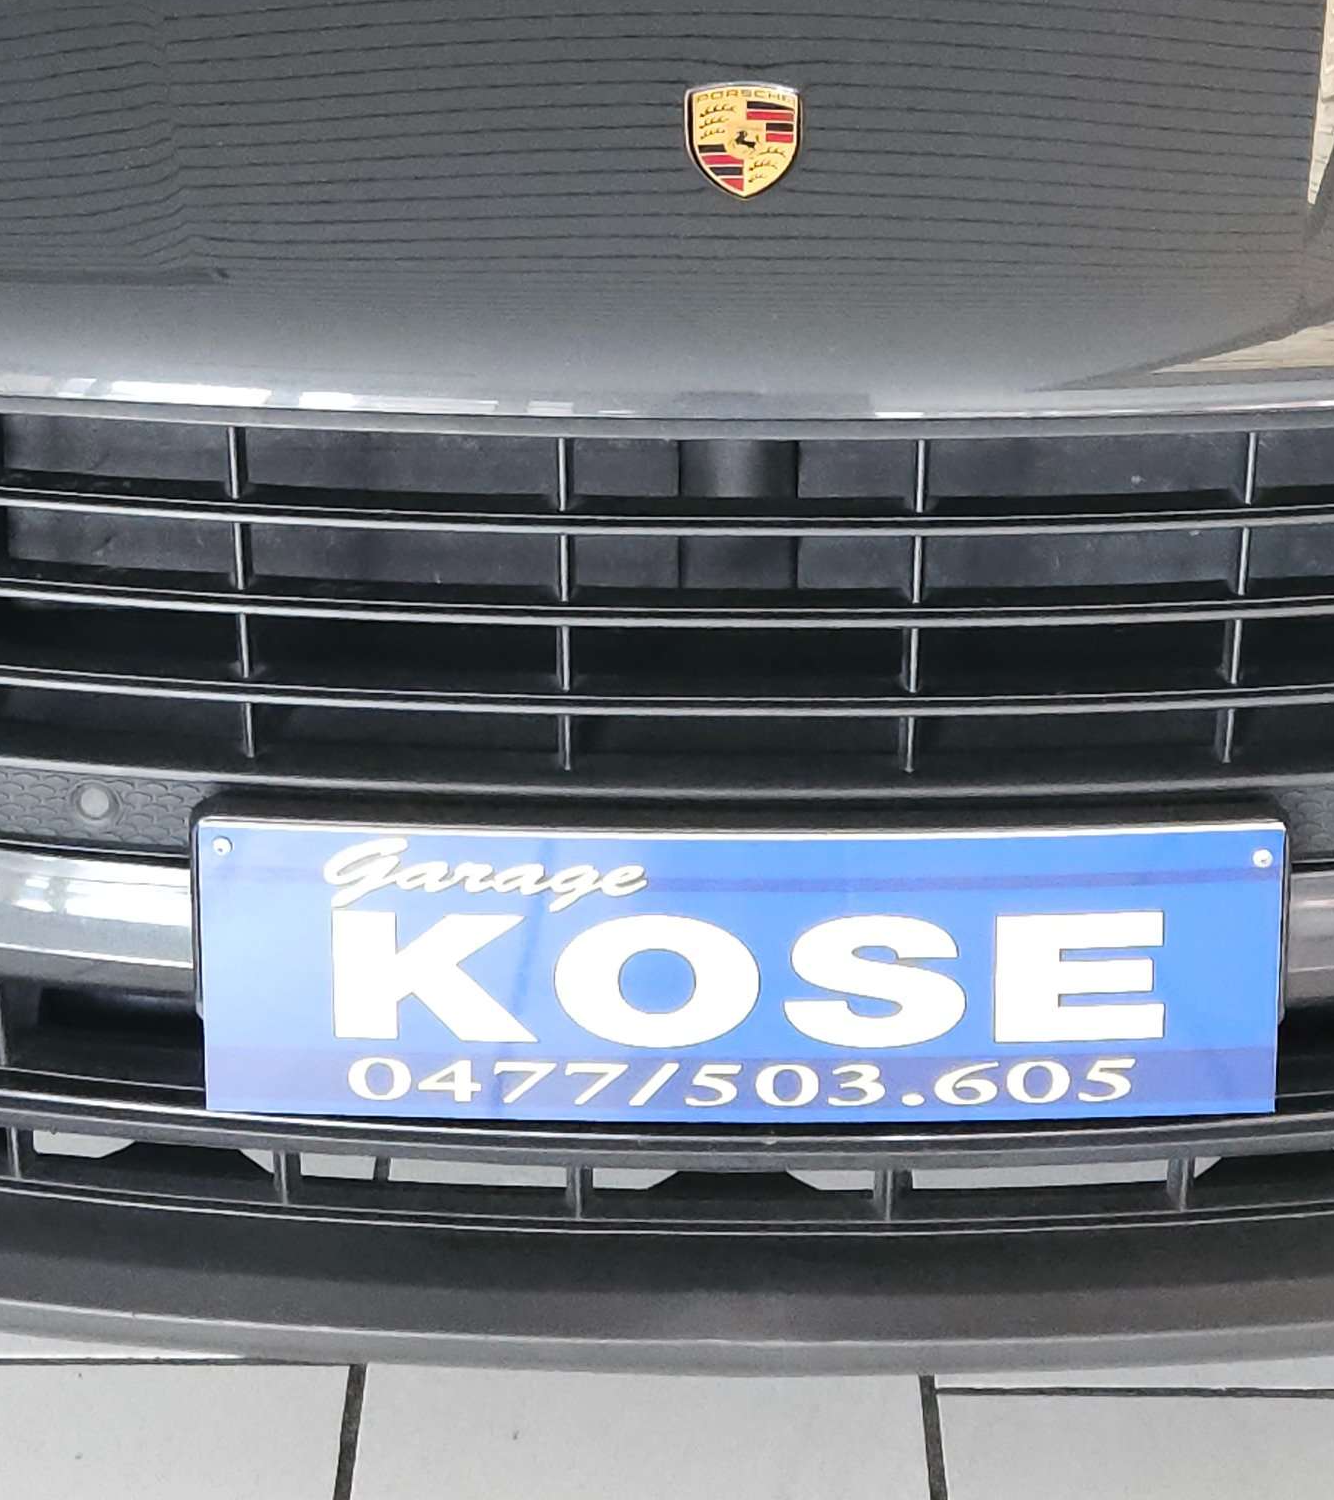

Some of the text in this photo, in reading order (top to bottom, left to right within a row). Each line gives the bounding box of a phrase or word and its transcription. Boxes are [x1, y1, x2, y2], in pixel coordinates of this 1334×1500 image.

[324, 837, 647, 912] Garage
[332, 911, 1165, 1048] KOSE
[348, 1057, 1135, 1106] 0477/503.605
